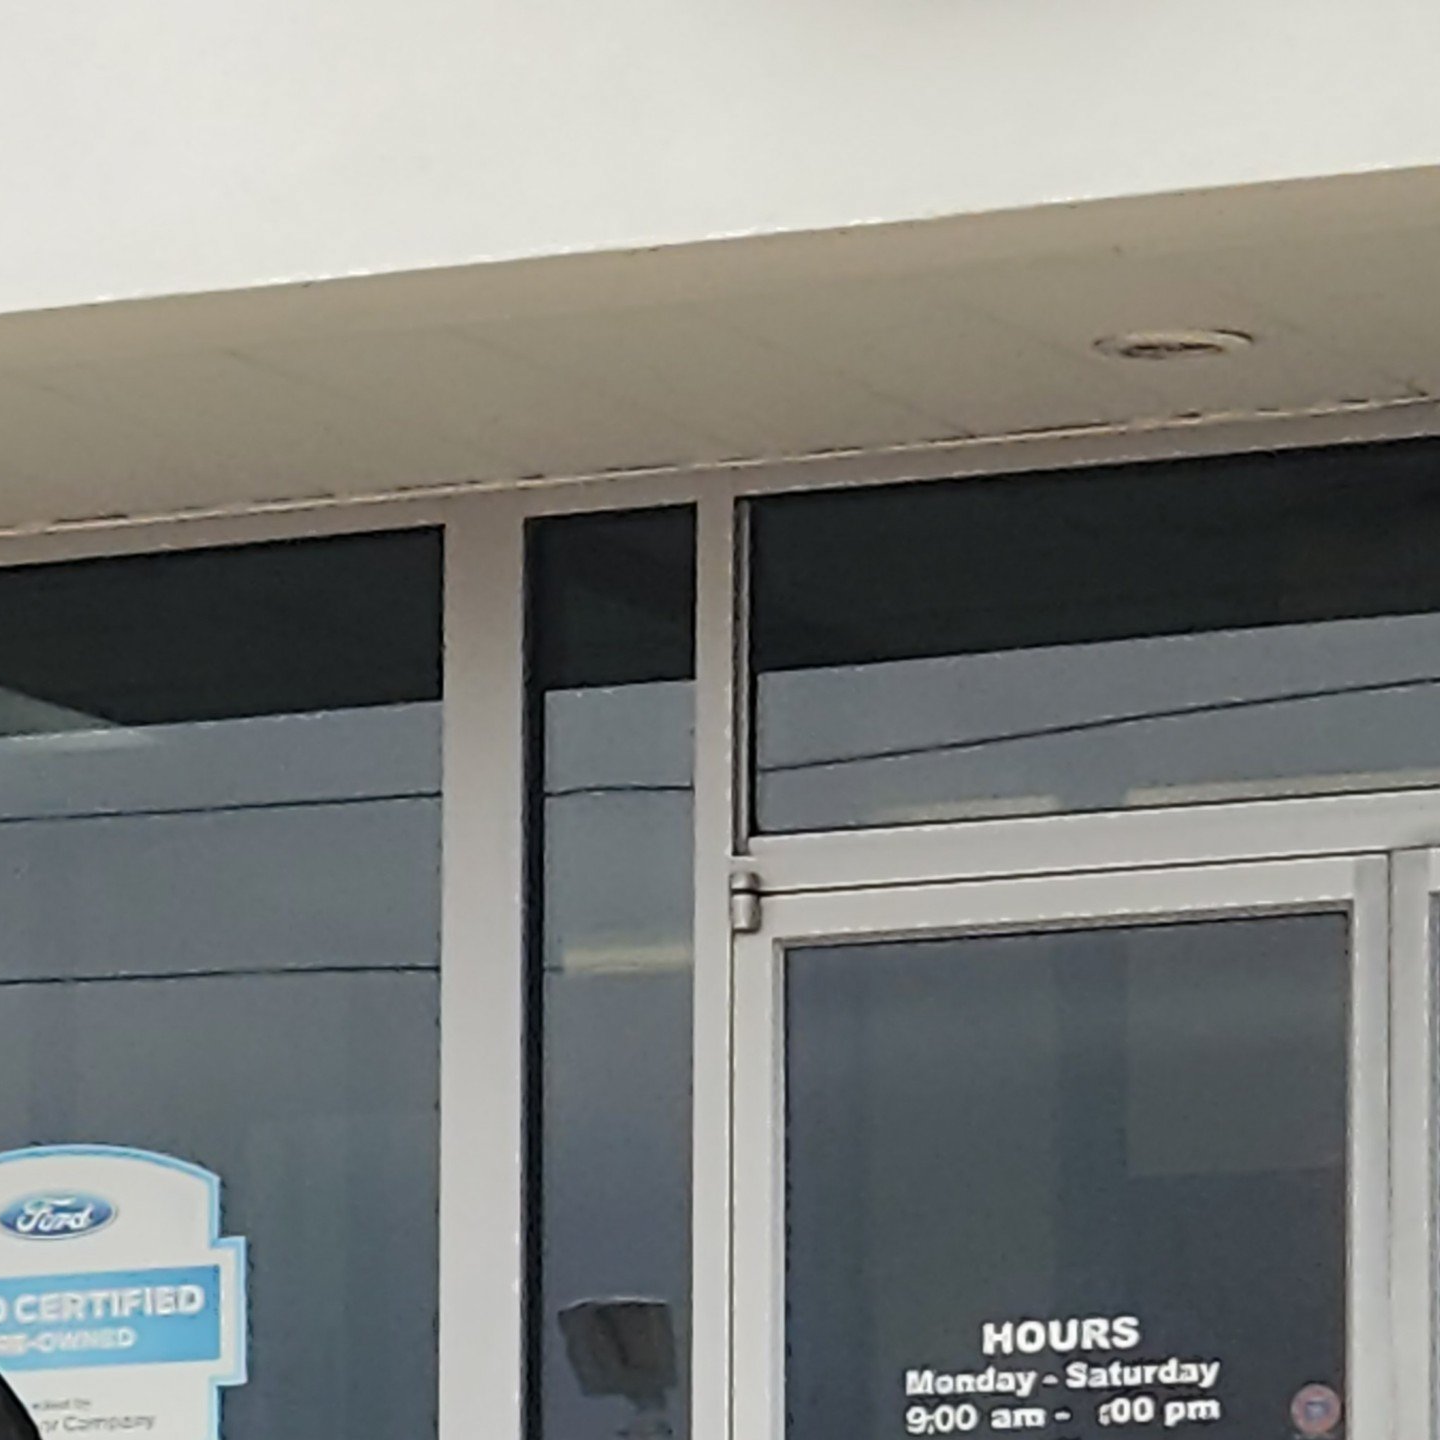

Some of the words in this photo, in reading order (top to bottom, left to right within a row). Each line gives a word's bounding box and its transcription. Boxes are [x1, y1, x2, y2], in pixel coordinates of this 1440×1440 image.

[14, 1285, 206, 1324] CERTIFIED
[982, 1316, 1141, 1356] HOURS
[905, 1367, 1037, 1397] Monday
[1065, 1358, 1220, 1389] Saturday
[905, 1405, 978, 1434] 9:00
[990, 1407, 1047, 1429] am
[1164, 1399, 1221, 1427] pm
